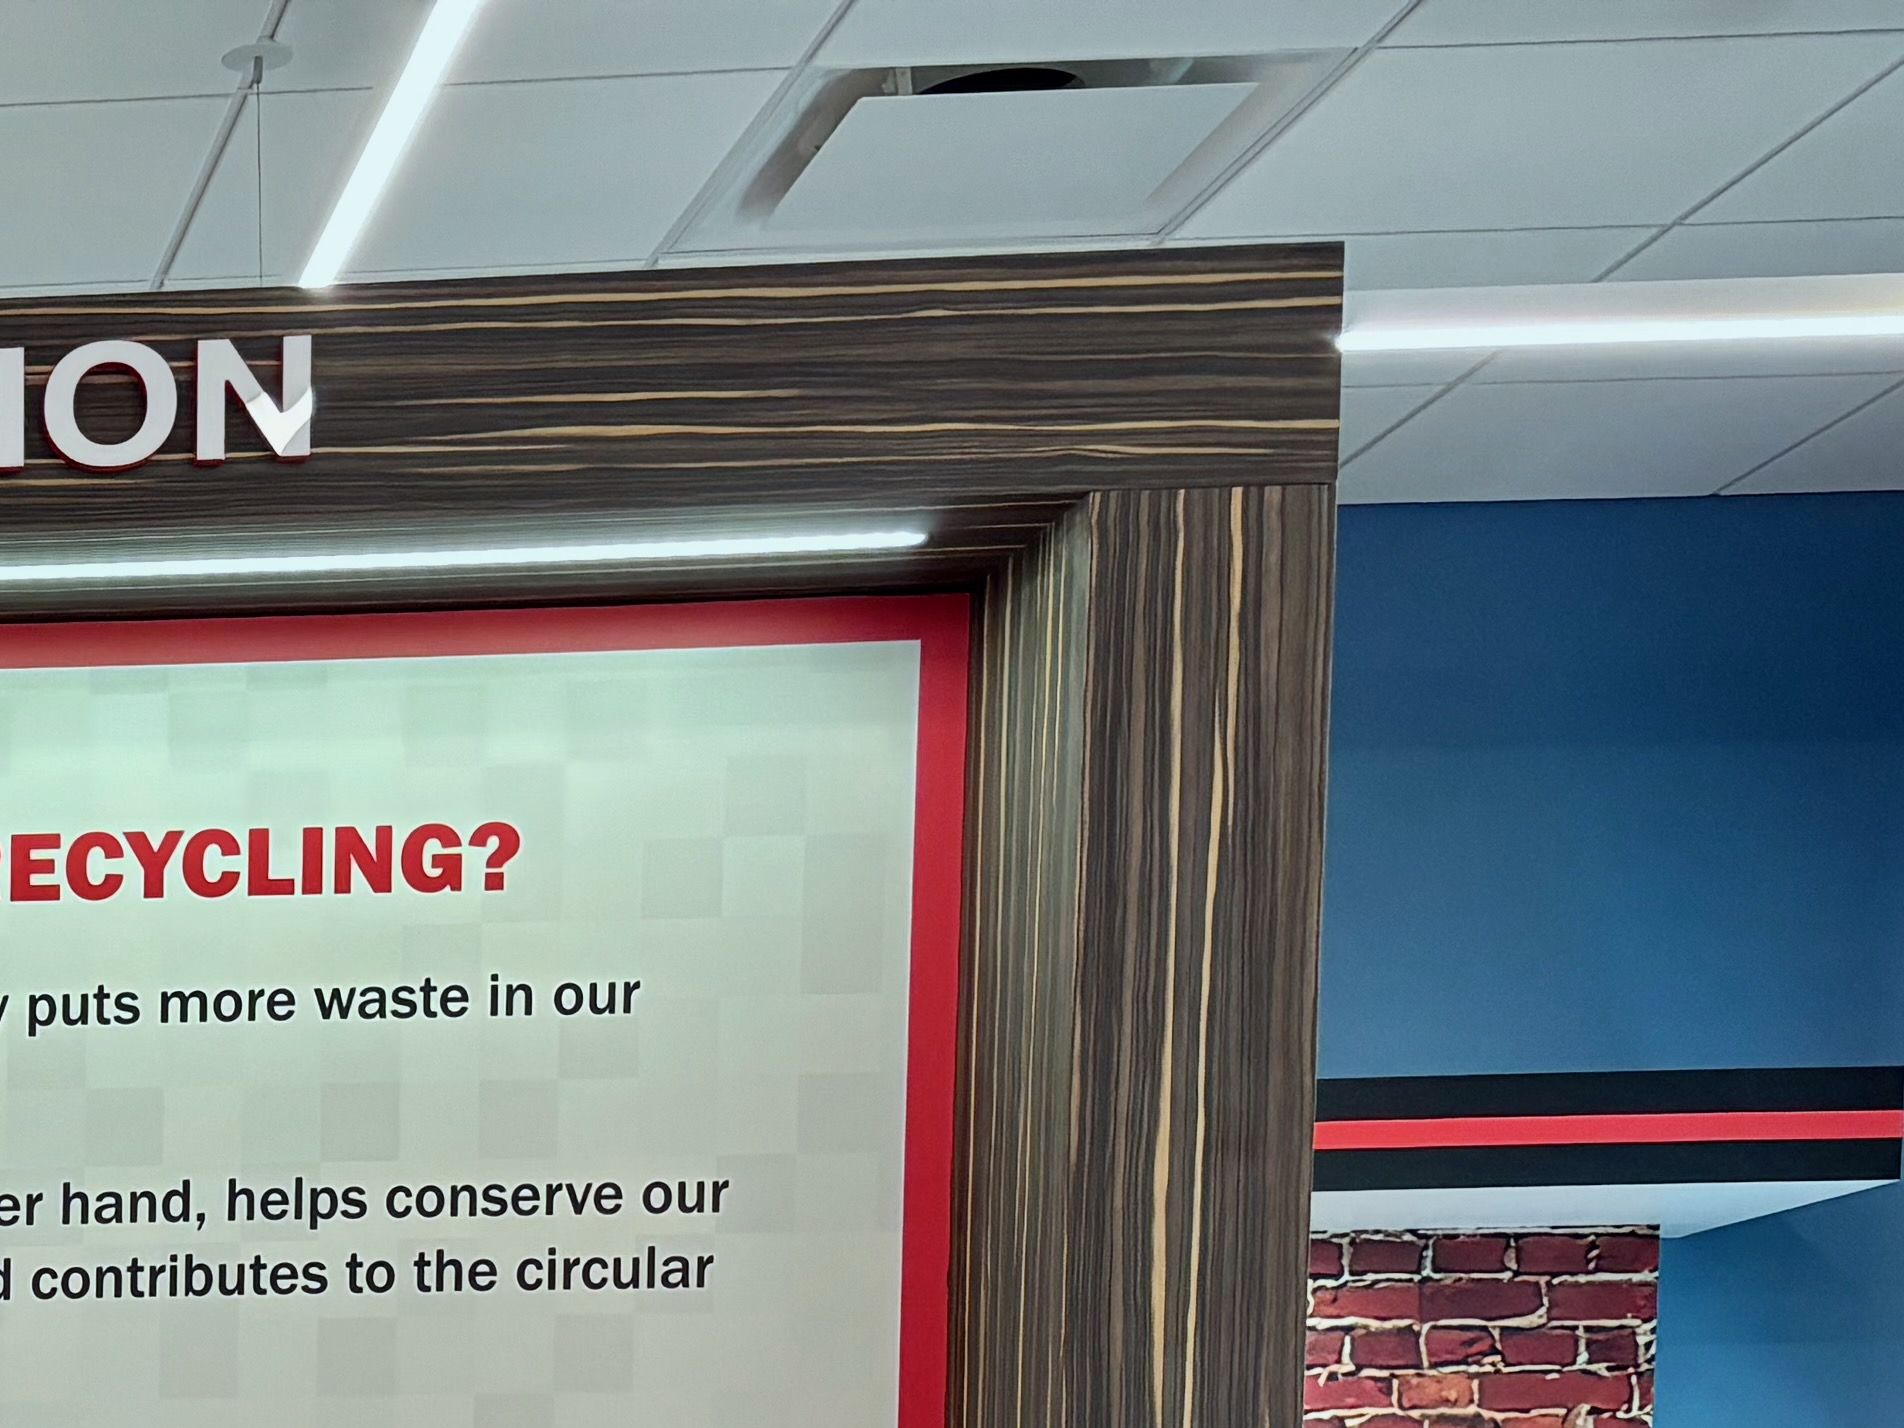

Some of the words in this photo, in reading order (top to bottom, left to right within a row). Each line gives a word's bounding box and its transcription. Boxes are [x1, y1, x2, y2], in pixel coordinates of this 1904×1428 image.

[27, 983, 142, 1039] puts
[159, 987, 297, 1025] more
[312, 976, 471, 1021] waste
[488, 972, 534, 1018] in
[552, 979, 642, 1017] our
[60, 1177, 207, 1233] hand,
[226, 1175, 369, 1232] helps
[384, 1180, 624, 1220] conserve
[641, 1178, 731, 1216] our
[30, 1252, 330, 1301] contributes
[344, 1251, 397, 1295] to
[412, 1247, 499, 1294] the
[515, 1244, 716, 1293] circular
